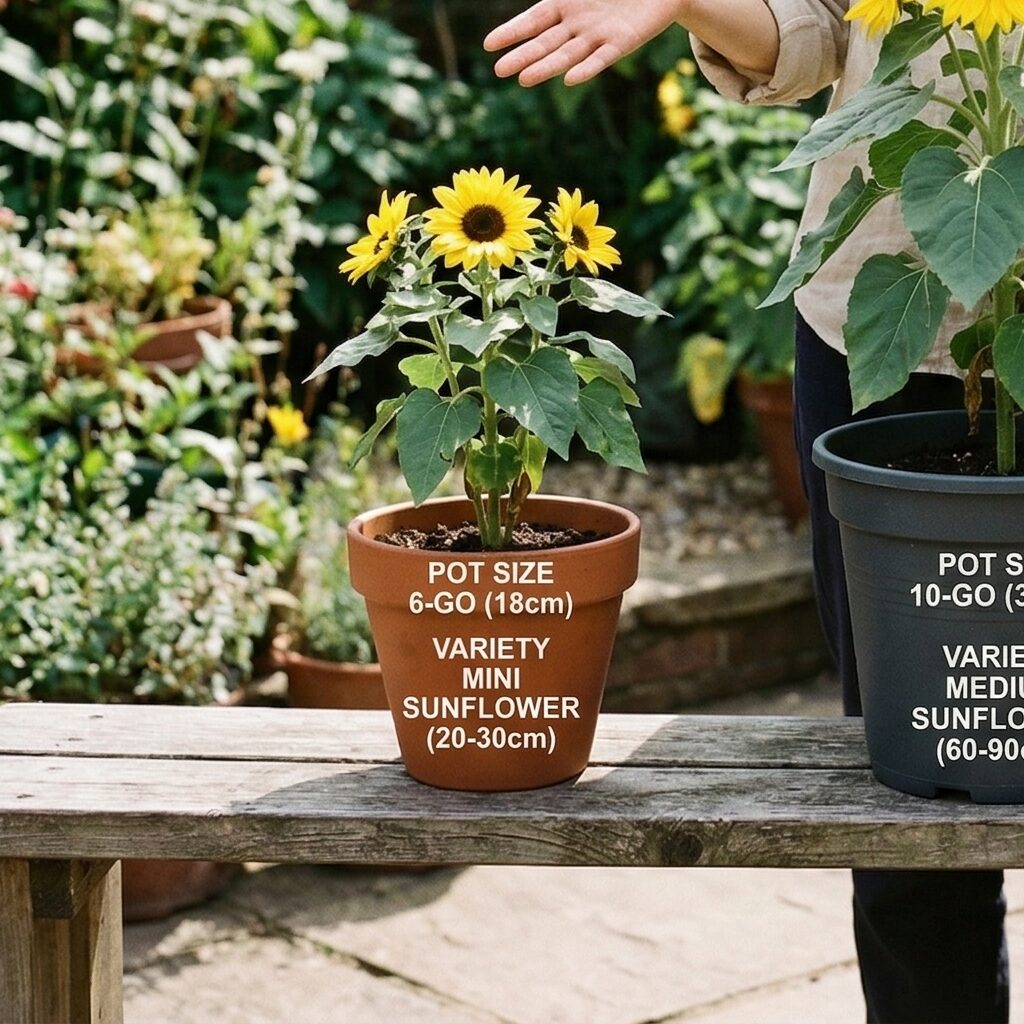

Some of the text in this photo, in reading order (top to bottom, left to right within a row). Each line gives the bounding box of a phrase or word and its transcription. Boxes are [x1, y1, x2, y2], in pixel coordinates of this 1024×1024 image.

[428, 561, 554, 585] POT SIZE
[939, 552, 997, 576] POT
[409, 591, 574, 620] 6-GO (18cm)
[910, 583, 996, 608] 10-GO
[432, 637, 550, 660] VARIETY
[462, 667, 521, 689] MINI
[402, 695, 581, 720] SUNFLOWER
[426, 726, 557, 754] (20-30cm)
